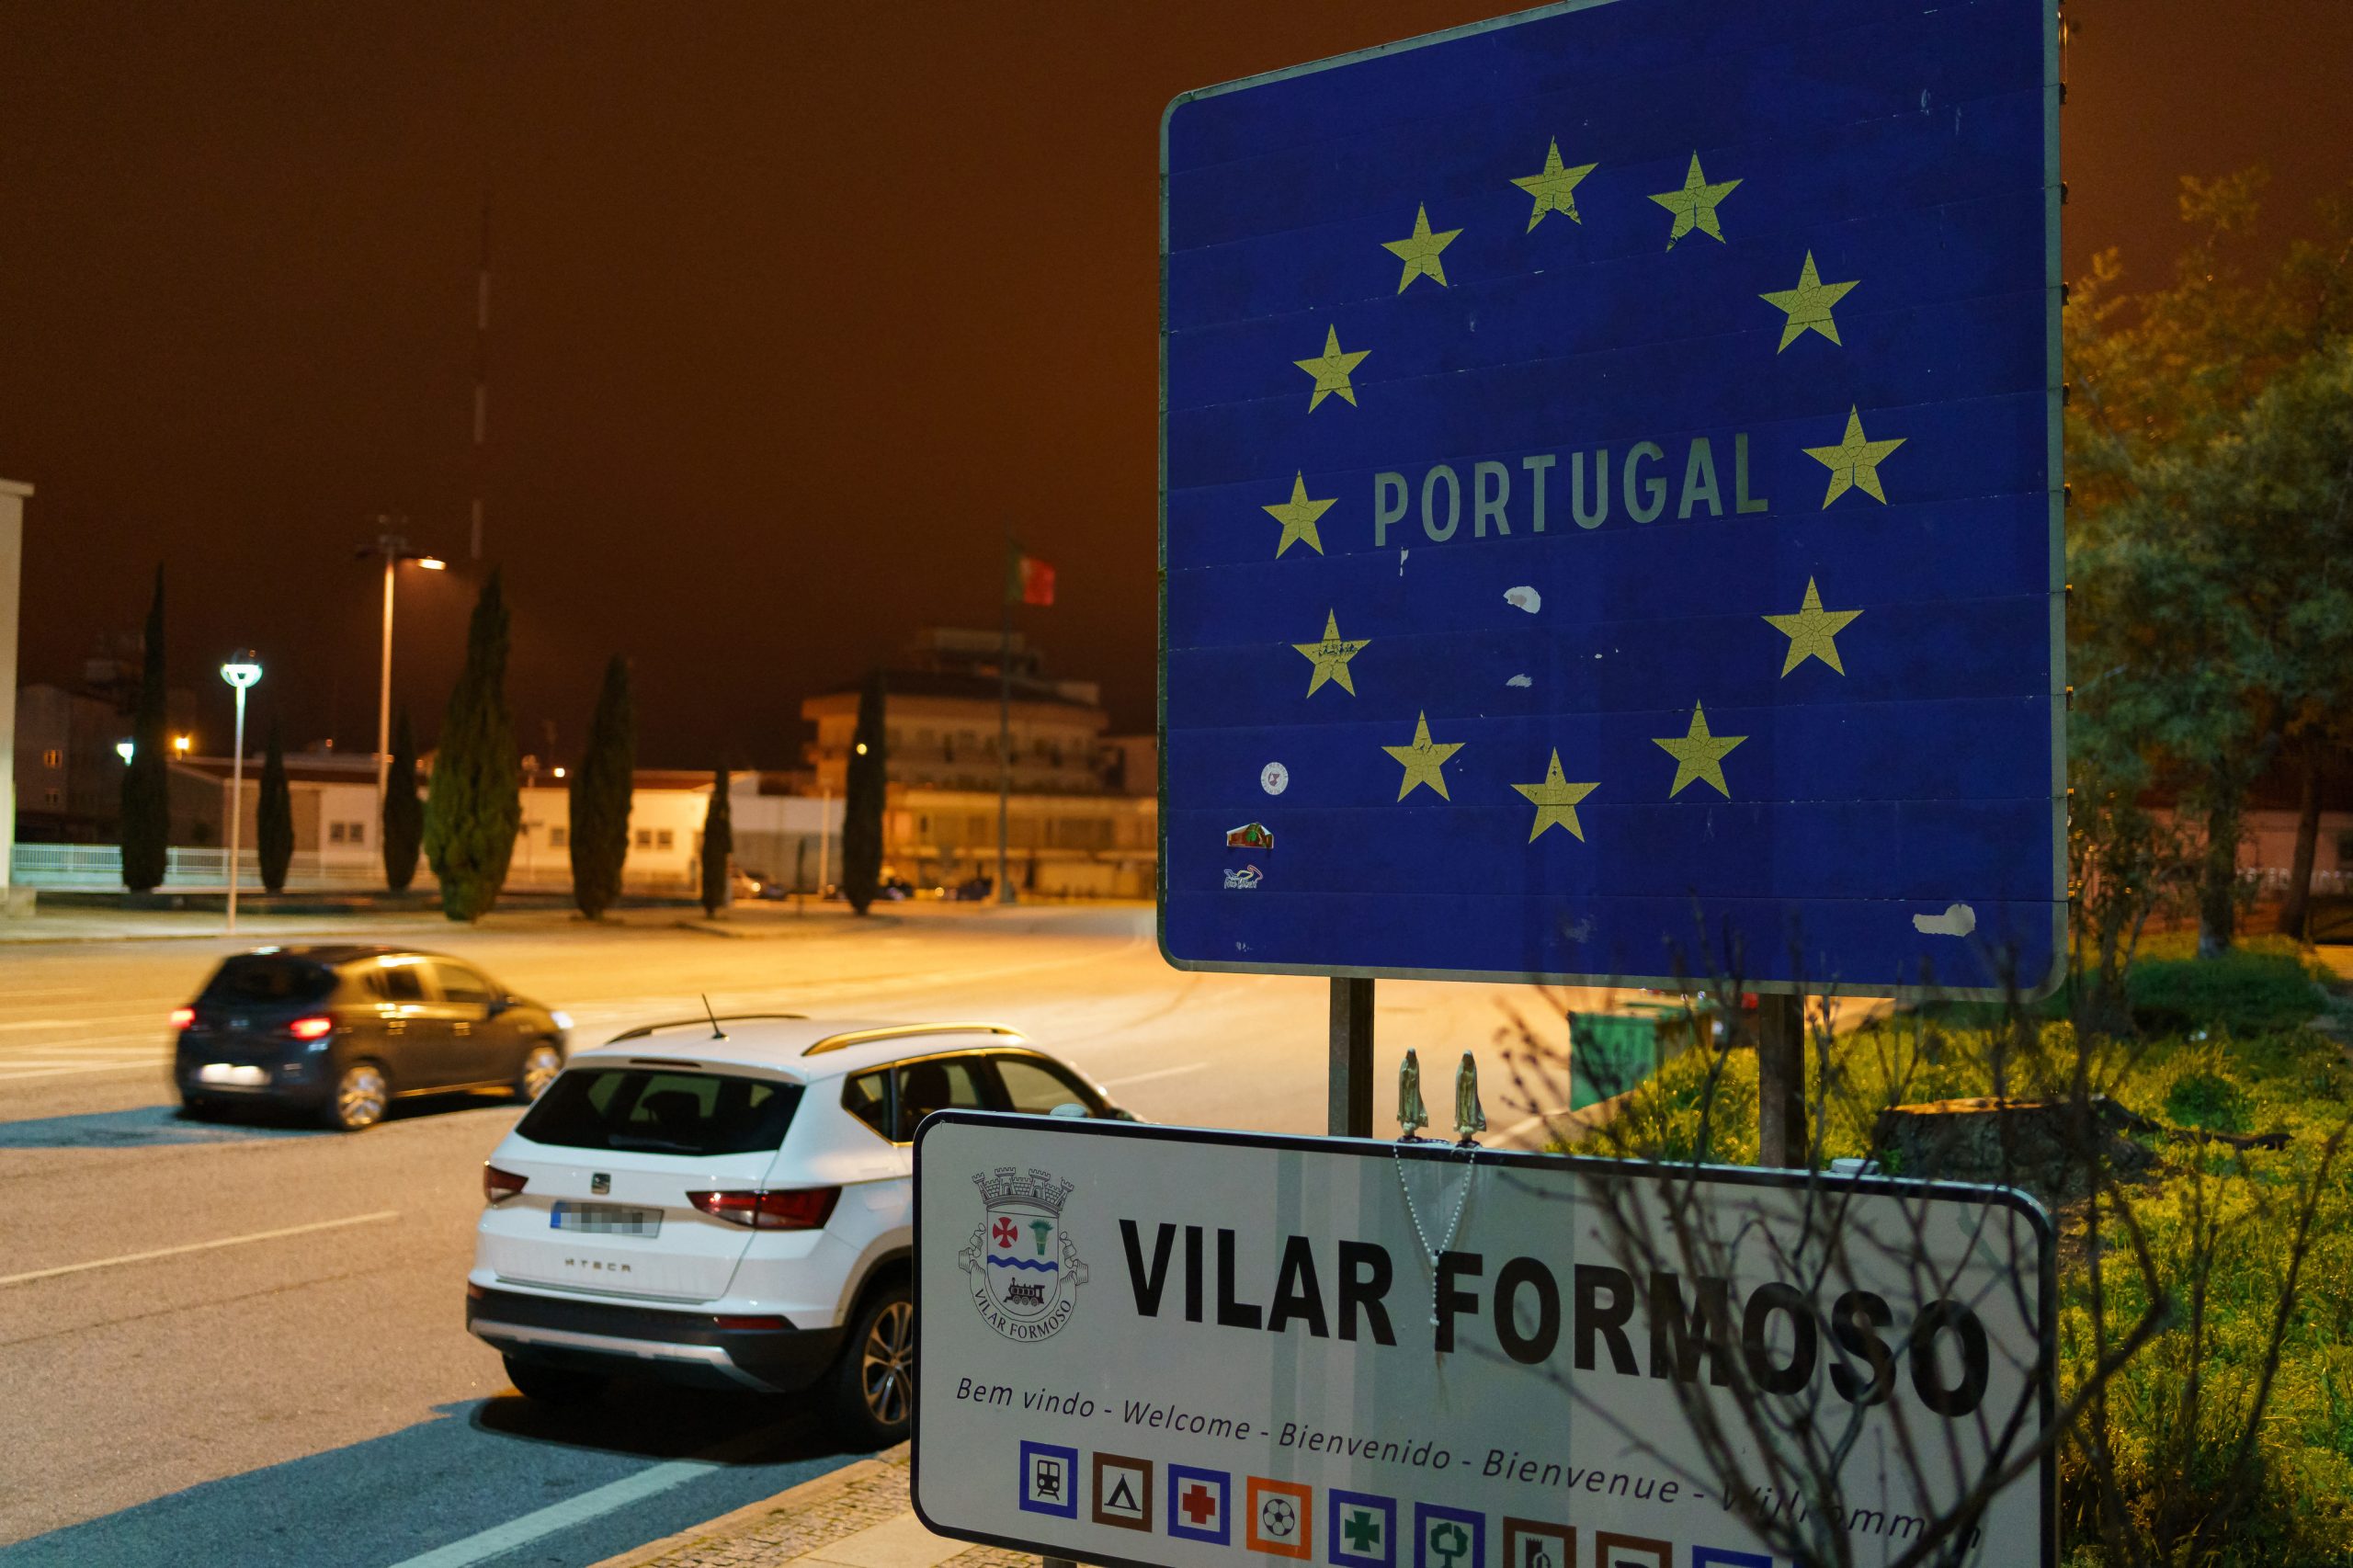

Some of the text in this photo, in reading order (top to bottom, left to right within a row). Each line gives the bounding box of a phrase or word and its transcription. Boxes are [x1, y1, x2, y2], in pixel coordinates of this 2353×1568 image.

[1374, 433, 1768, 547] PORTUGAL
[975, 1289, 1072, 1339] VILAR FORMOSO
[1118, 1219, 1990, 1417] VILAR FORMOSO
[956, 1378, 1012, 1406] Bem
[1023, 1390, 1095, 1418] vindo
[1123, 1400, 1250, 1440] Welcome
[1279, 1422, 1450, 1470] Bienvenido
[1483, 1449, 1679, 1505] Bienvenue
[1723, 1483, 1981, 1549] Willmmn
